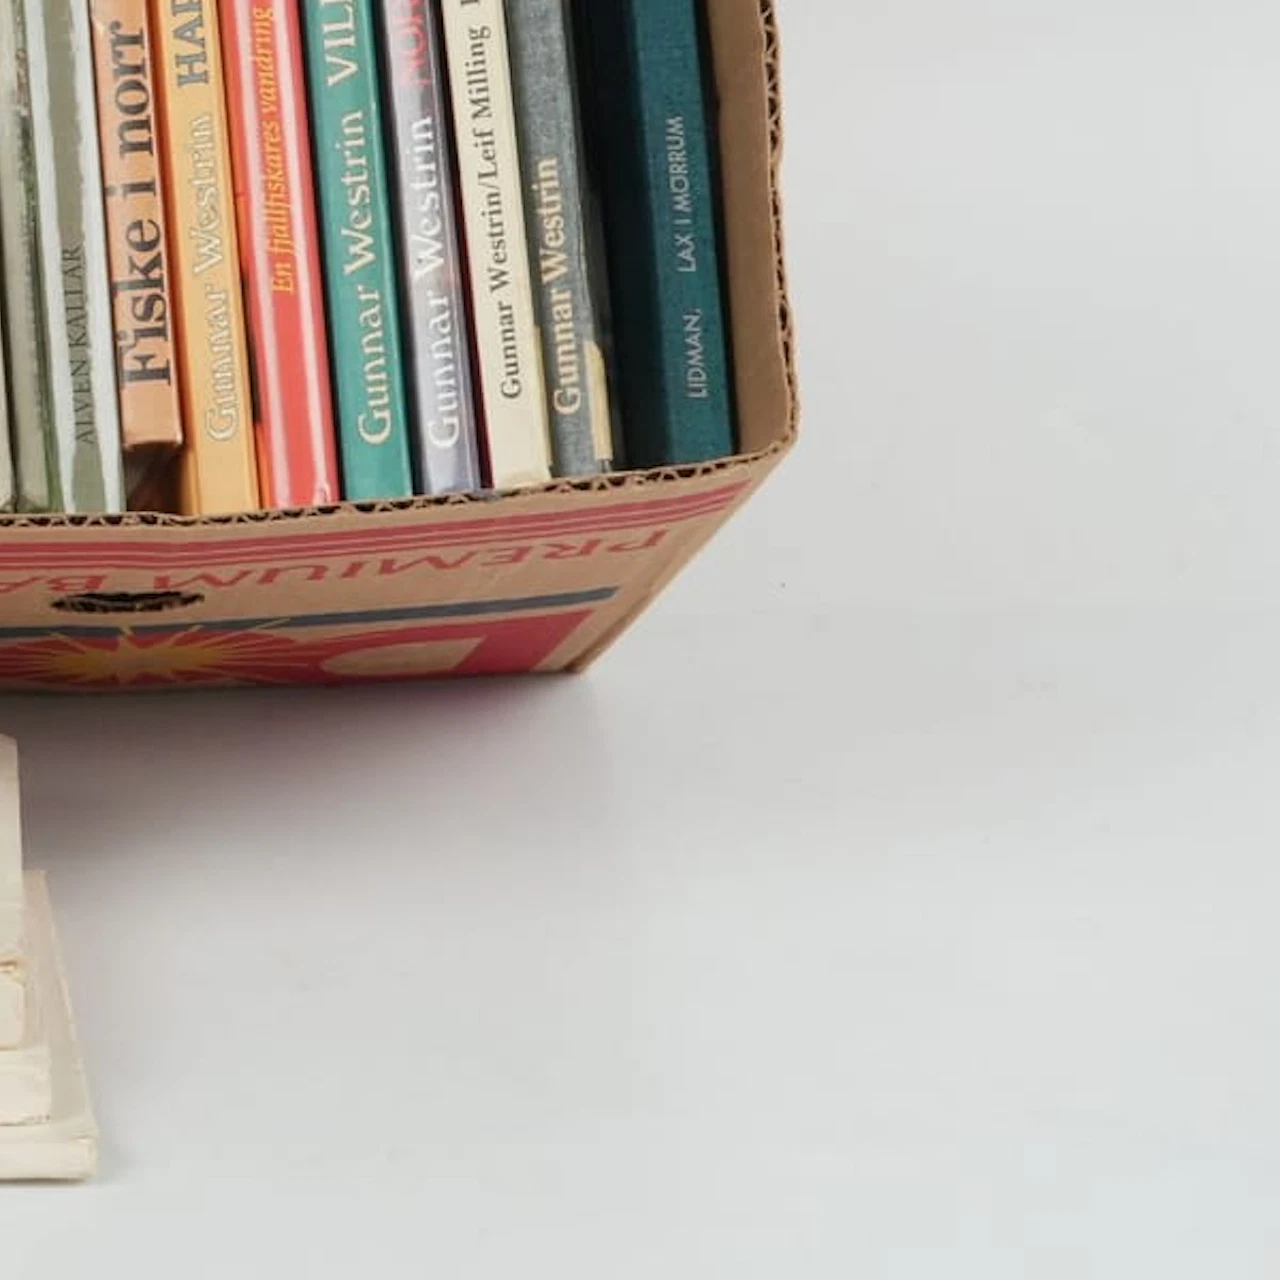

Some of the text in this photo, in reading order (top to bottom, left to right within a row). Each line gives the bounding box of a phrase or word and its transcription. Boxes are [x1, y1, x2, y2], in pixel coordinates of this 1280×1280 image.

[105, 20, 155, 157] norr
[247, 5, 279, 115] vandring
[462, 25, 495, 120] Milling
[105, 180, 158, 198] i
[186, 114, 227, 275] Westrin
[335, 110, 377, 275] Westrin
[405, 116, 447, 280] Westrin
[468, 127, 512, 293] Westrin/Leif
[532, 157, 571, 283] Westrin
[671, 232, 698, 273] LAX
[108, 218, 172, 386] Fiske
[269, 261, 296, 293] En
[192, 282, 242, 442] Gunnar
[354, 285, 395, 445] Gunnar
[426, 289, 462, 449] Gunnar
[492, 299, 525, 401] Gunnar
[549, 286, 584, 416] Gunnar
[153, 529, 672, 591] PREMIUM
